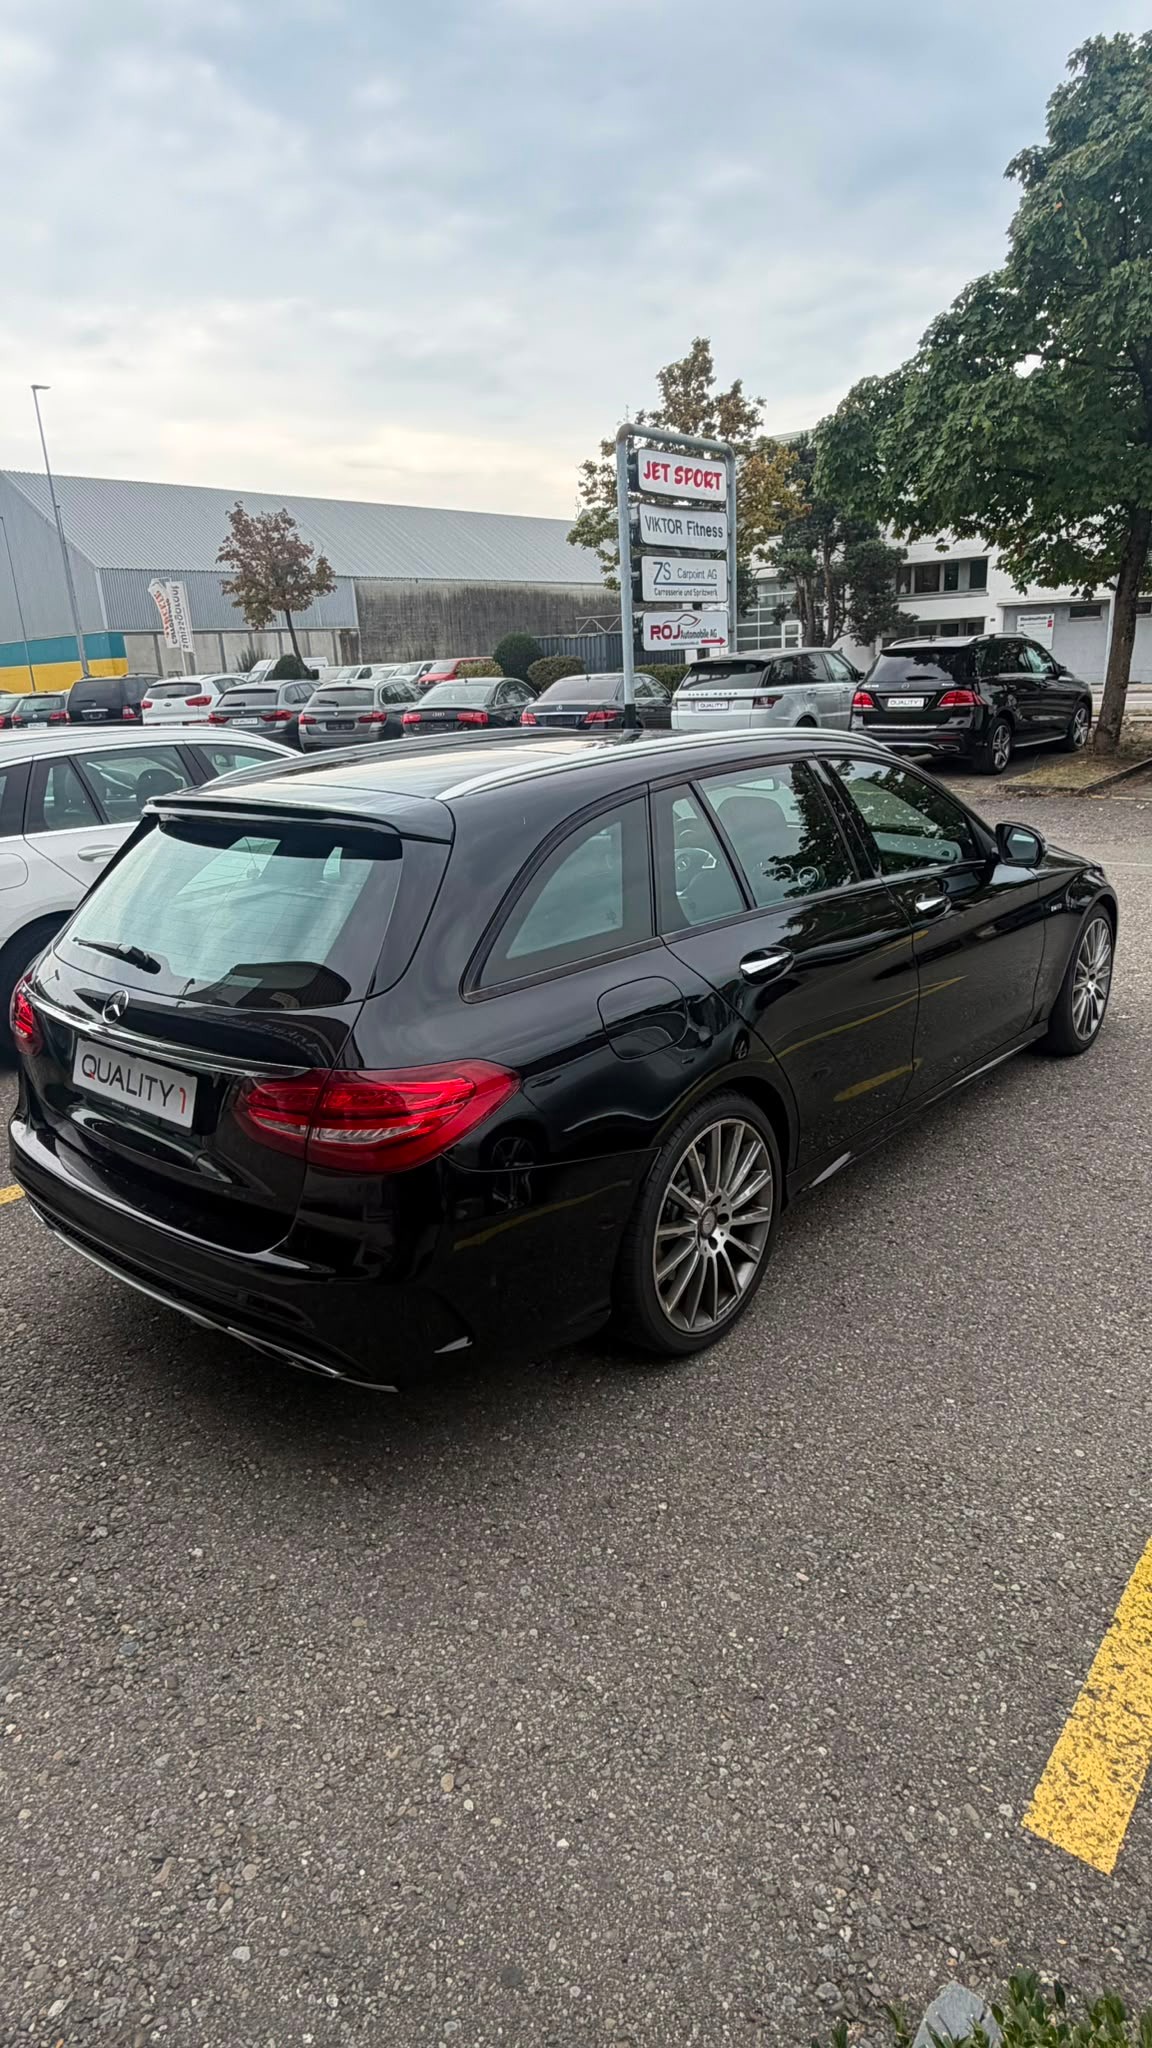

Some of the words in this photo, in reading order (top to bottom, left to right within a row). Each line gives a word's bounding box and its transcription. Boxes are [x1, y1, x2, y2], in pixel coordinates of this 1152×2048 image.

[643, 460, 671, 483] JET
[674, 465, 723, 490] SPORT
[644, 515, 683, 535] VIKTOR
[686, 520, 724, 538] Fitness
[677, 567, 706, 581] Carpoint
[707, 568, 718, 580] AG
[654, 587, 683, 597] Carrosserie
[683, 588, 693, 597] und
[650, 624, 681, 640] ROJ
[680, 627, 710, 640] Automobile
[710, 628, 718, 639] AG
